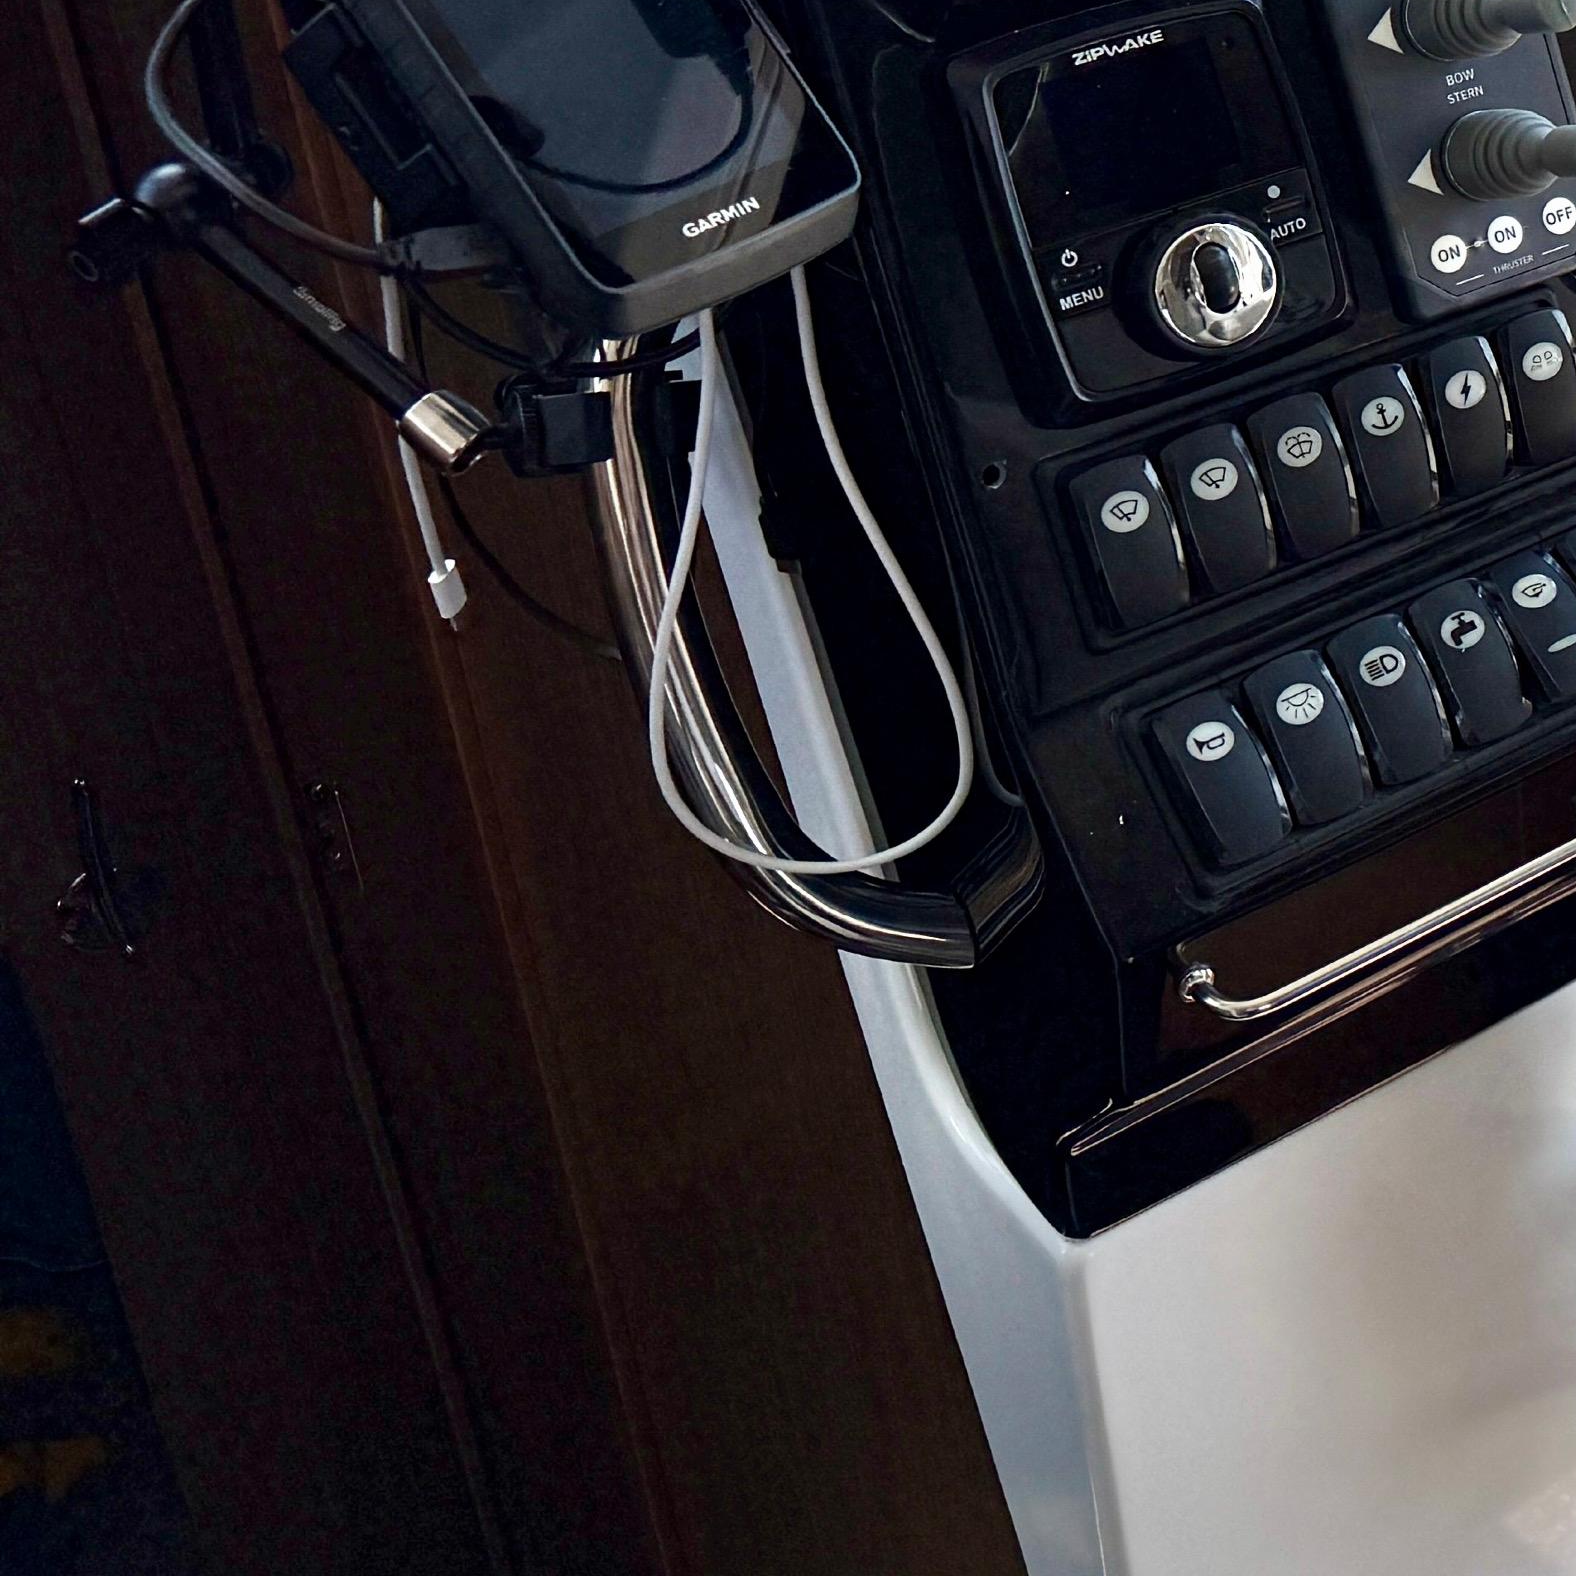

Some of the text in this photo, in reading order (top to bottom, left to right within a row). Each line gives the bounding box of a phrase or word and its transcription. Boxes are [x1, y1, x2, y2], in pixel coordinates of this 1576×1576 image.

[1445, 68, 1475, 87] BOW
[1447, 85, 1484, 105] STERN
[682, 196, 760, 238] GARMIN
[1545, 206, 1573, 226] OFF
[1270, 217, 1307, 241] AUTO
[1494, 225, 1517, 244] ON
[1438, 245, 1461, 263] ON
[1492, 254, 1535, 275] THRUSTER
[1059, 286, 1104, 311] MENU
